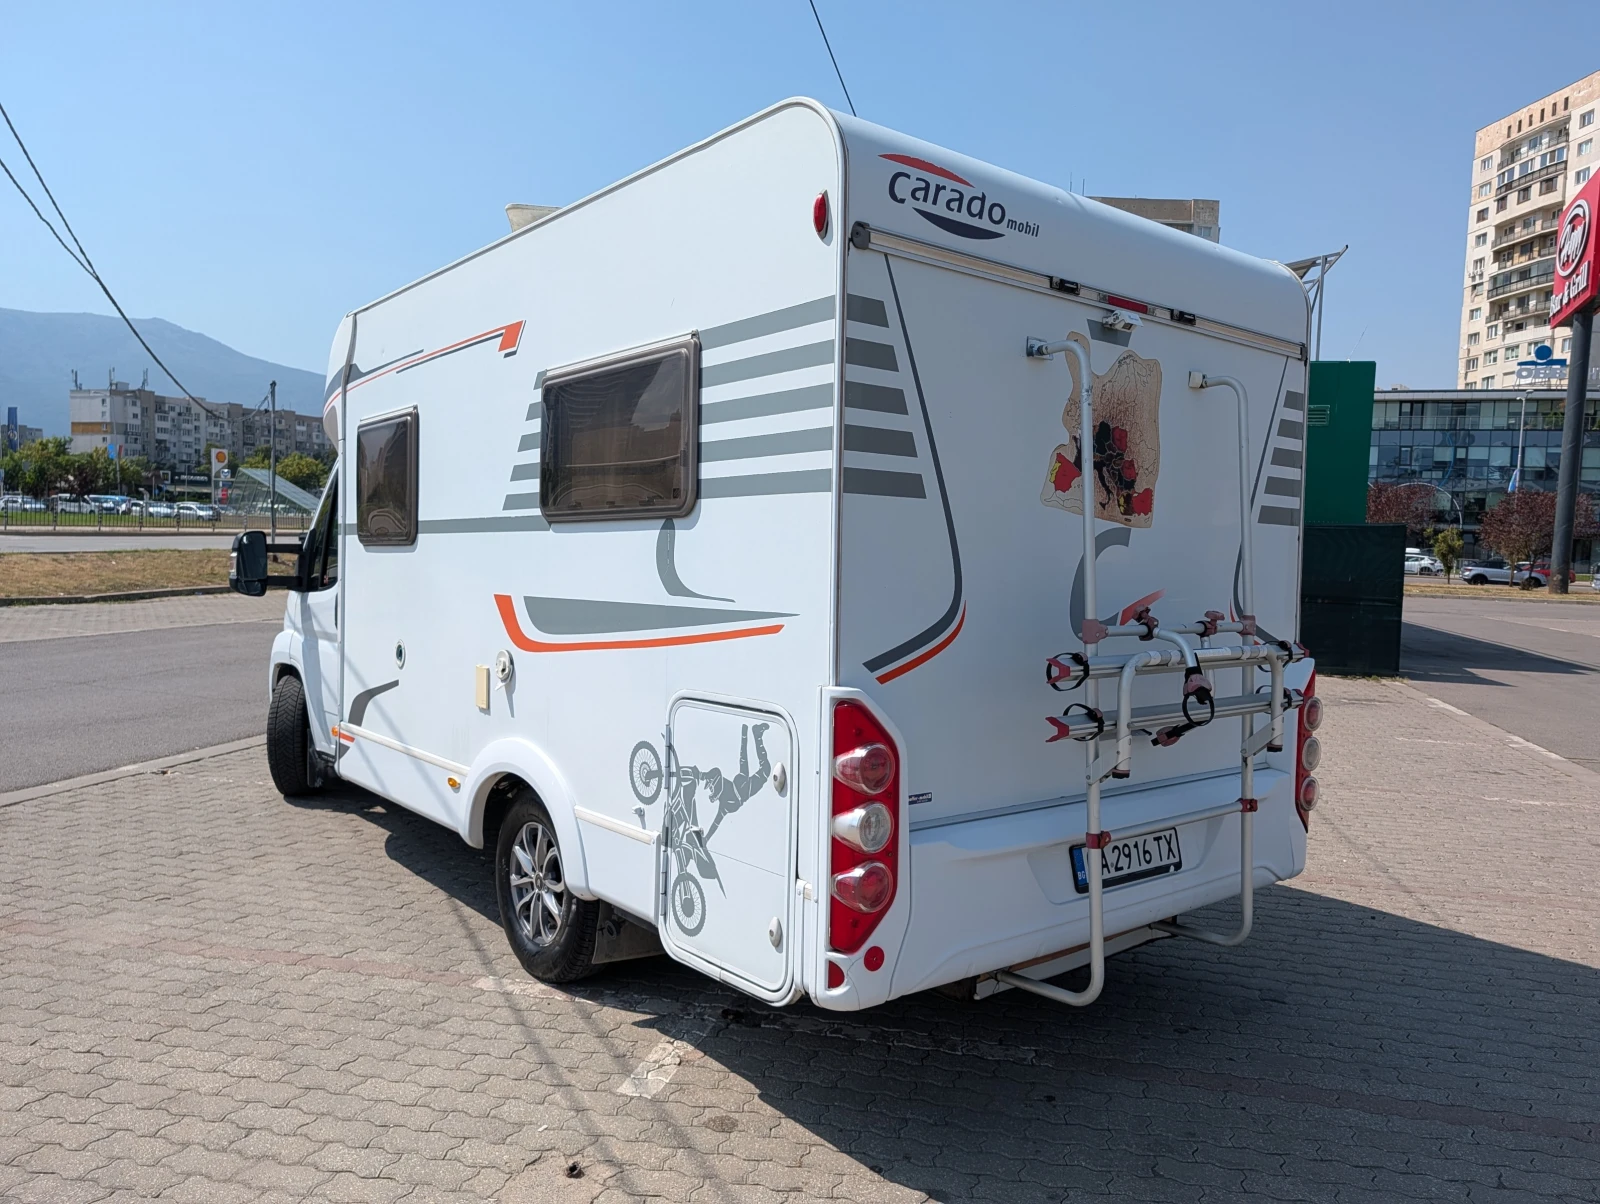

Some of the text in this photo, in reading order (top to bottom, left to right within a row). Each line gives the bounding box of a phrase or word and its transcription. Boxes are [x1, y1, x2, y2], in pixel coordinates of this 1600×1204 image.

[1006, 219, 1040, 238] mobil
[1549, 260, 1589, 318] Bar & Grill
[1077, 871, 1086, 880] BG
